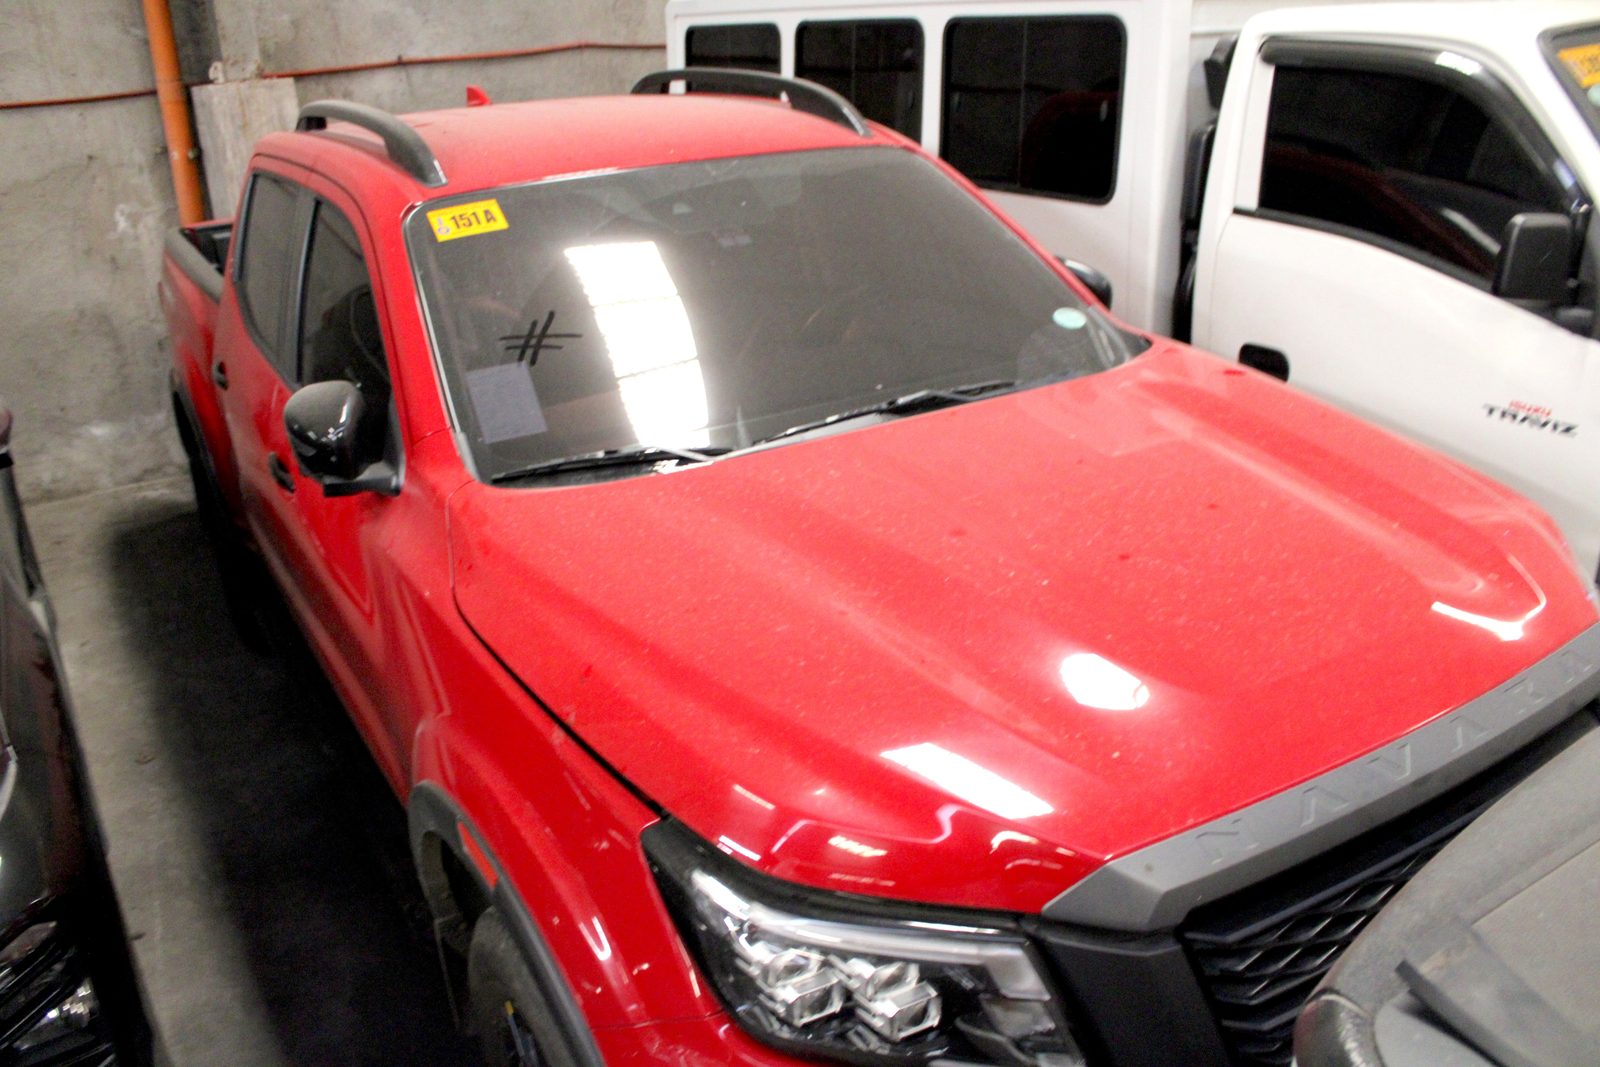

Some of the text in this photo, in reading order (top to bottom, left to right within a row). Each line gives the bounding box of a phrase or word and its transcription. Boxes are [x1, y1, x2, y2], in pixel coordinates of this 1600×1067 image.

[450, 211, 481, 230] 151
[483, 208, 498, 224] A
[1482, 403, 1577, 438] TRAVIZ
